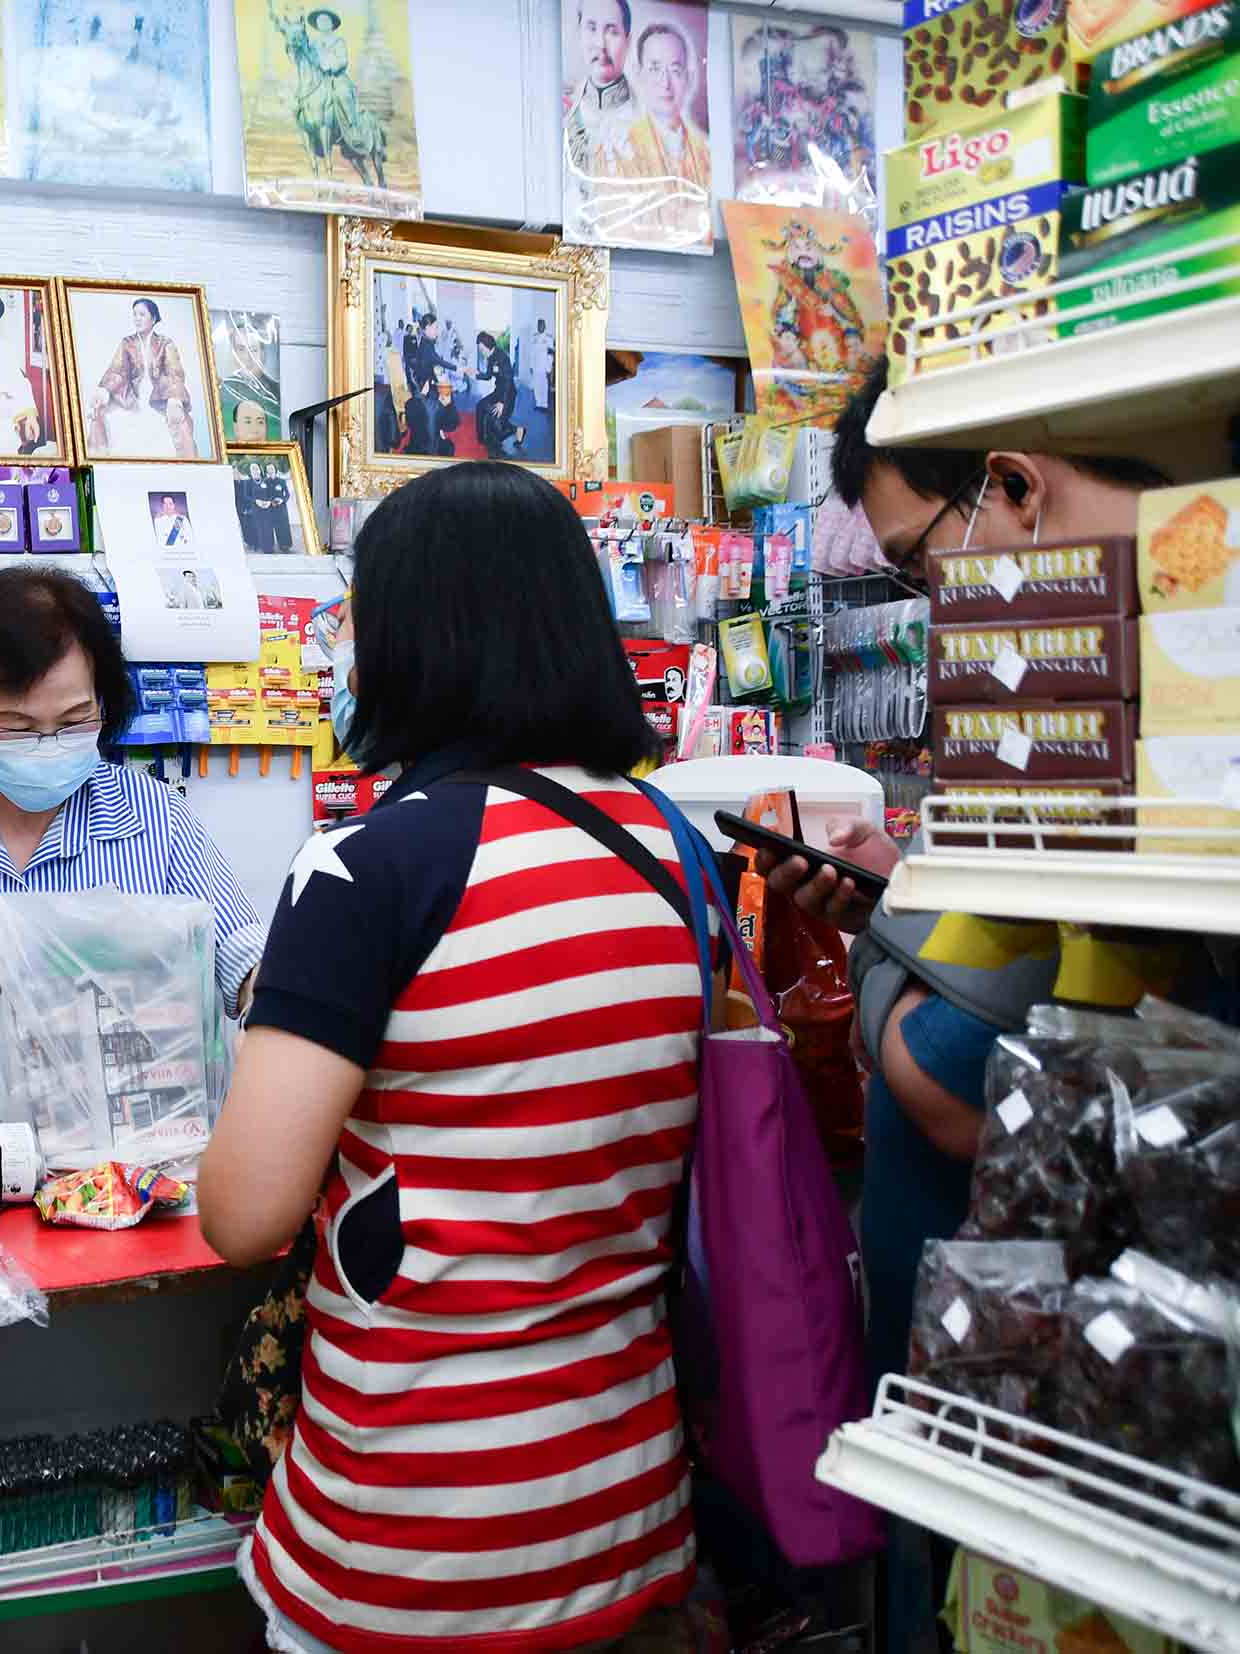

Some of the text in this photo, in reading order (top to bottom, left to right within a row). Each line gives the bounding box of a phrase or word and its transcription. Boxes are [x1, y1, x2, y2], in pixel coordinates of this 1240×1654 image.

[923, 130, 1009, 177] Ligo
[905, 194, 1030, 251] RAISINS
[939, 577, 1107, 604] KURM ANGKAI
[939, 656, 1108, 680] KURM ANGKAI
[944, 741, 1110, 760] KURM ANGKAI
[315, 781, 356, 793] Gillette
